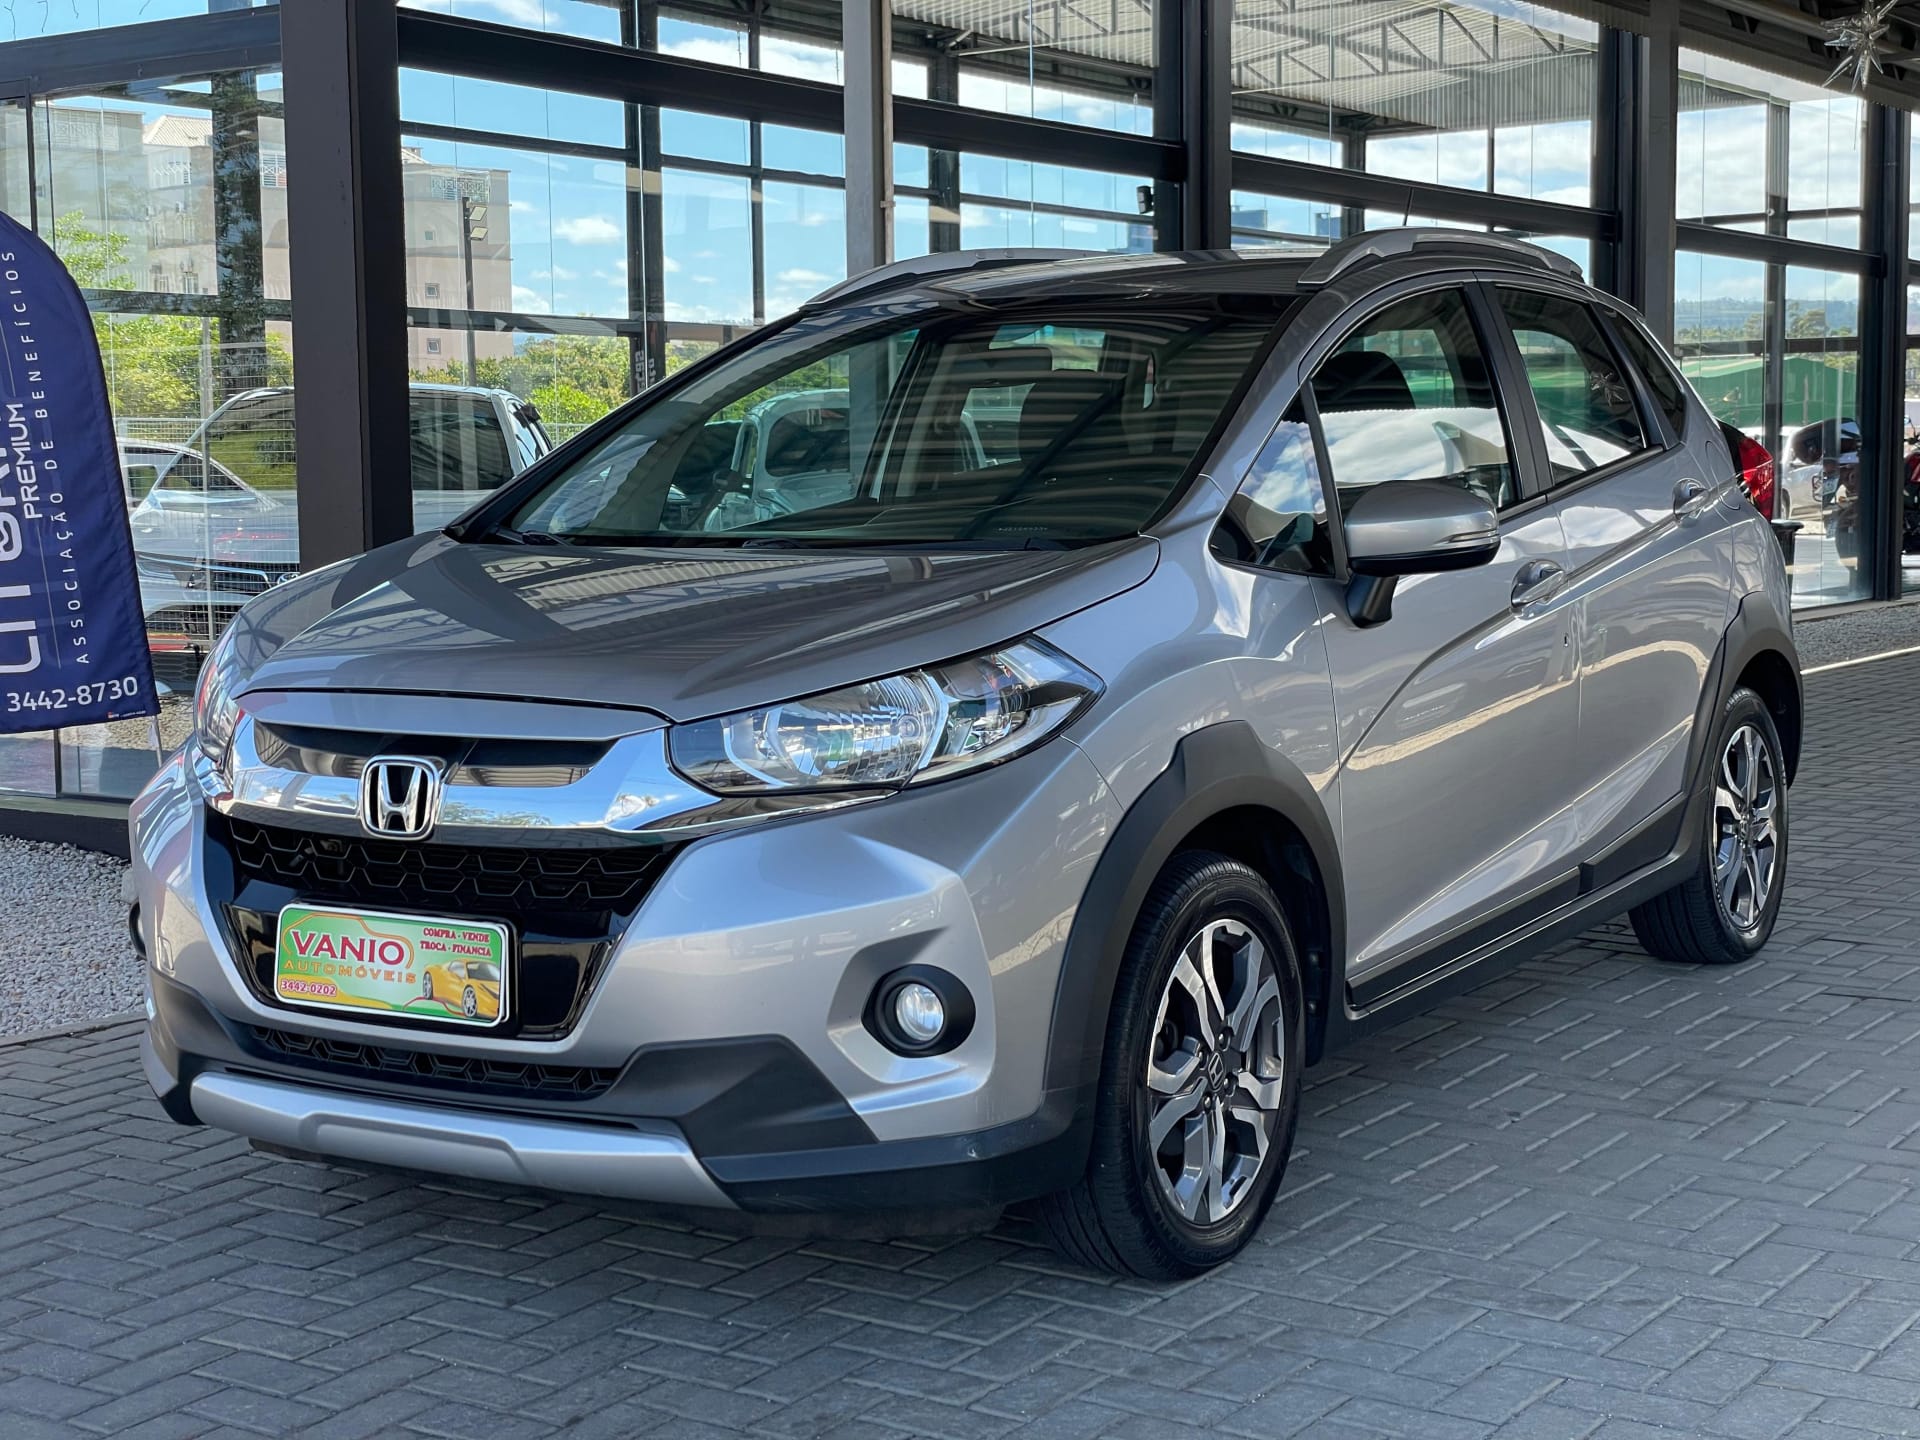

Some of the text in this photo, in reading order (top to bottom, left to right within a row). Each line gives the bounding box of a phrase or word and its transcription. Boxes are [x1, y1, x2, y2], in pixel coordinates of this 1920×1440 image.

[2, 252, 48, 419] BENEFÍCIOS
[6, 403, 43, 519] PREMIUM
[41, 440, 58, 470] DE
[50, 492, 90, 664] ASSOCIAÇÃO
[7, 676, 138, 712] 3442-8730
[291, 930, 405, 966] VANIO
[420, 940, 447, 951] TROCA
[452, 943, 491, 957] FINANCIA
[423, 927, 456, 939] COMPRA
[462, 931, 490, 943] VENDE
[280, 979, 337, 996] 3442-0202
[283, 959, 417, 984] AUTOMÓVEIS
